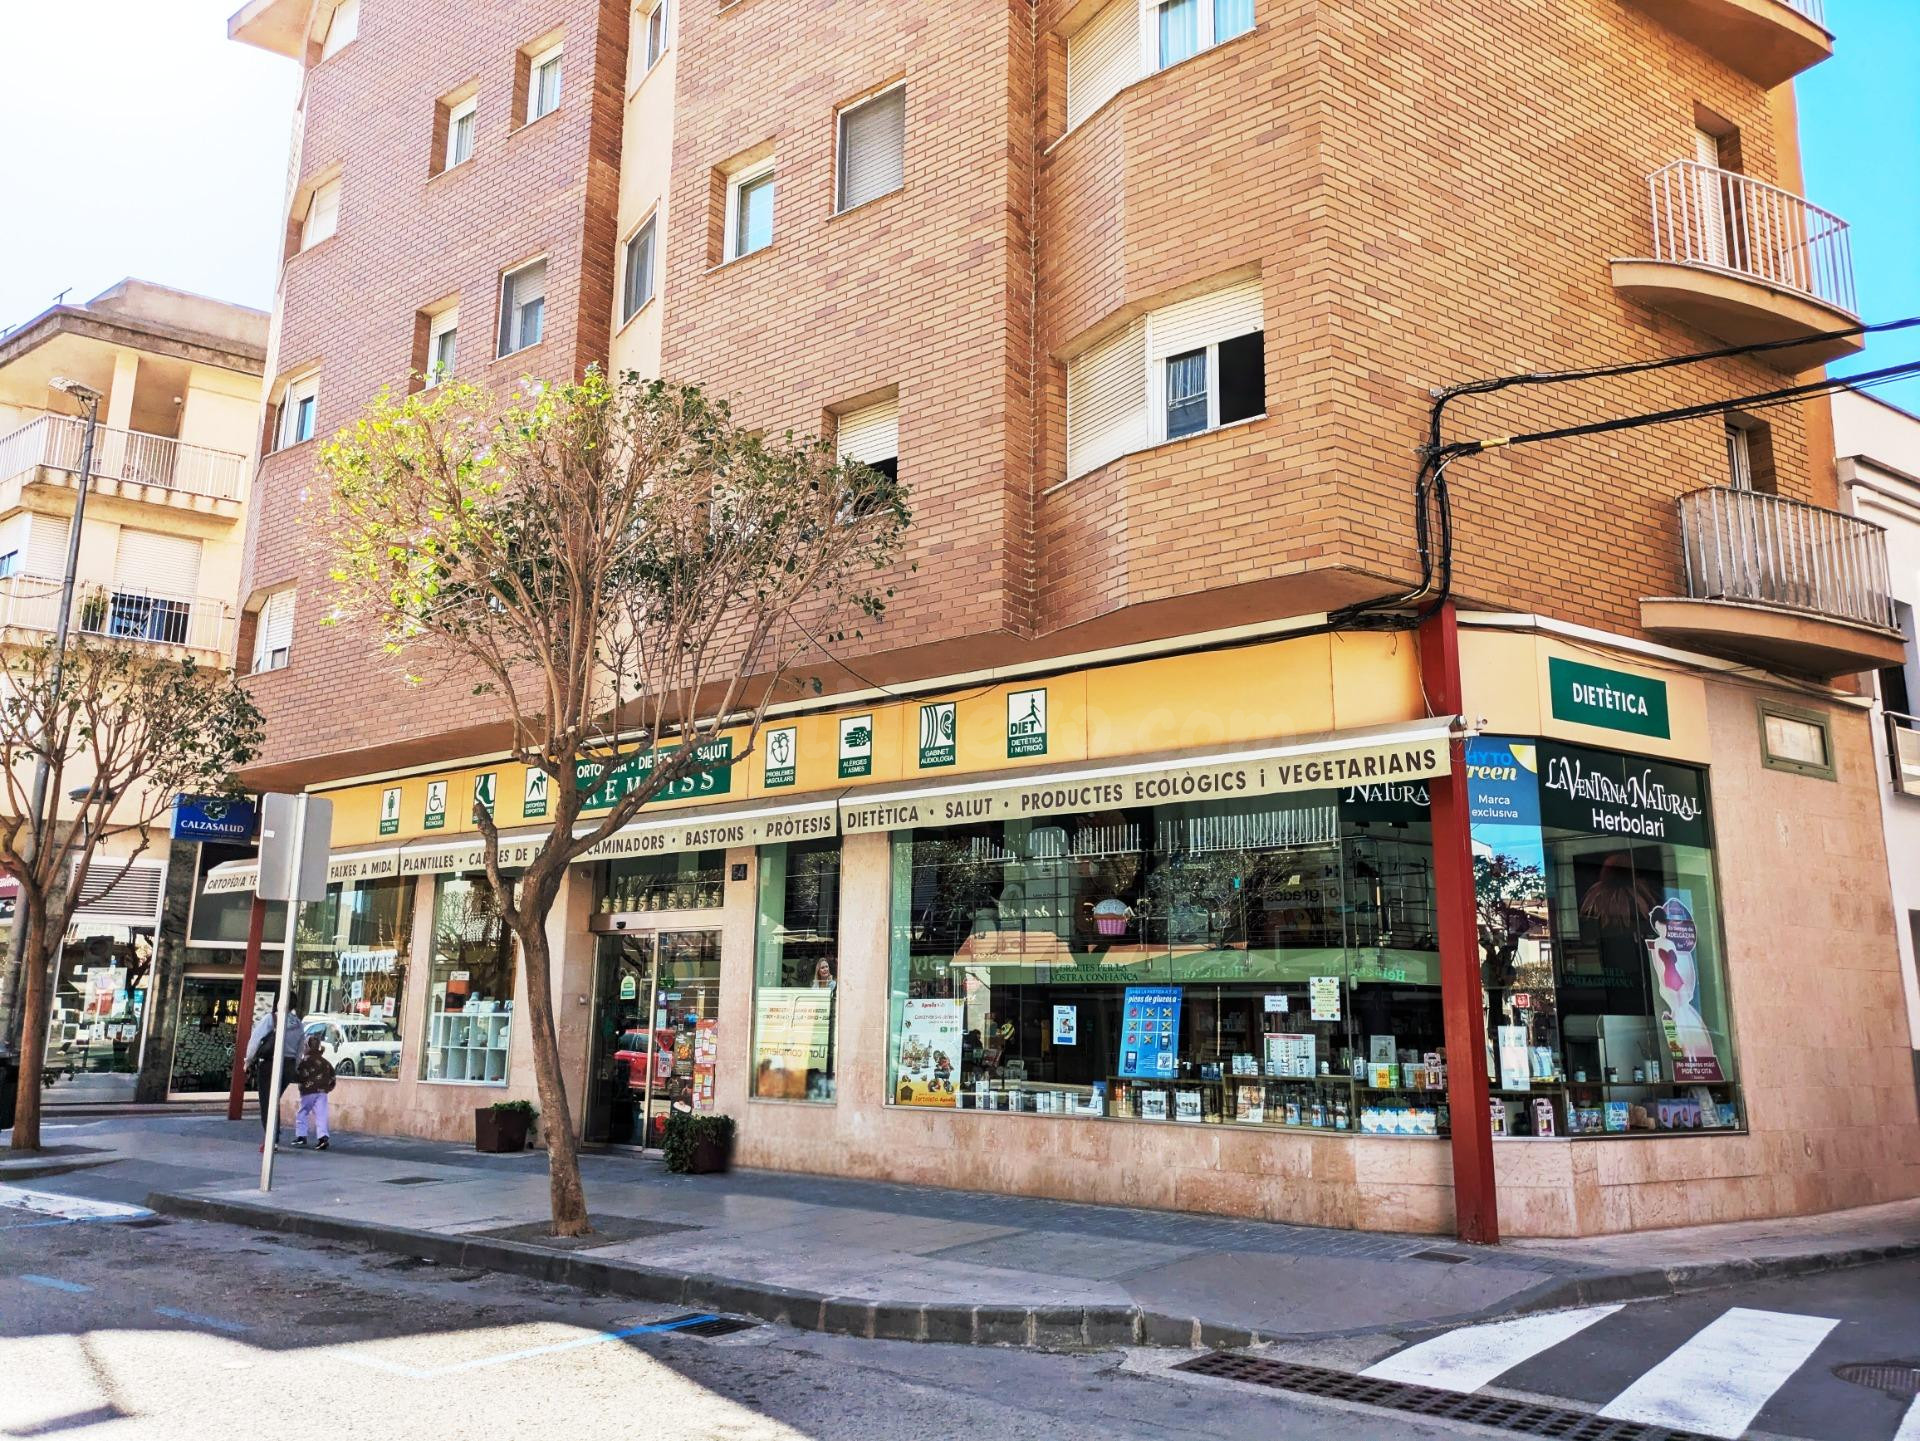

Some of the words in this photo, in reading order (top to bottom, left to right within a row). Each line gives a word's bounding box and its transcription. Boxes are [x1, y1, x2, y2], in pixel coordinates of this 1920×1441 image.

[1572, 682, 1649, 717] DIETÈTICA
[1010, 721, 1036, 736] DIET
[1011, 737, 1043, 747] DIETÈTICA
[1015, 743, 1043, 753] NUTRICIÓ
[697, 744, 728, 763] SALUT
[925, 748, 949, 757] GABINET
[1466, 751, 1513, 766] HYTO
[848, 766, 865, 774] ASMES
[1466, 765, 1517, 781] reen
[765, 776, 794, 785] VASCULARS
[847, 803, 919, 829] DIETÈTICA
[945, 798, 993, 819] SALUT
[1021, 783, 1124, 812] PRODUCTES
[1135, 771, 1247, 800] ECOLÒGICS
[1260, 768, 1265, 788] i
[1278, 748, 1437, 786] VEGETARIANS
[1630, 768, 1702, 822] NATURAL
[1478, 793, 1511, 805] Marca
[1471, 808, 1518, 819] exclusiva
[180, 819, 245, 834] CALZASALUD
[1592, 807, 1666, 838] Herbolari
[587, 835, 665, 857] CAMINADORS
[686, 825, 745, 846] BASTONS
[766, 814, 832, 837] PRÒTESIS
[403, 853, 455, 872] PLANTILLES
[515, 847, 528, 862] DE
[330, 865, 357, 879] FAIXES
[361, 864, 368, 875] A
[371, 859, 392, 874] MIDA
